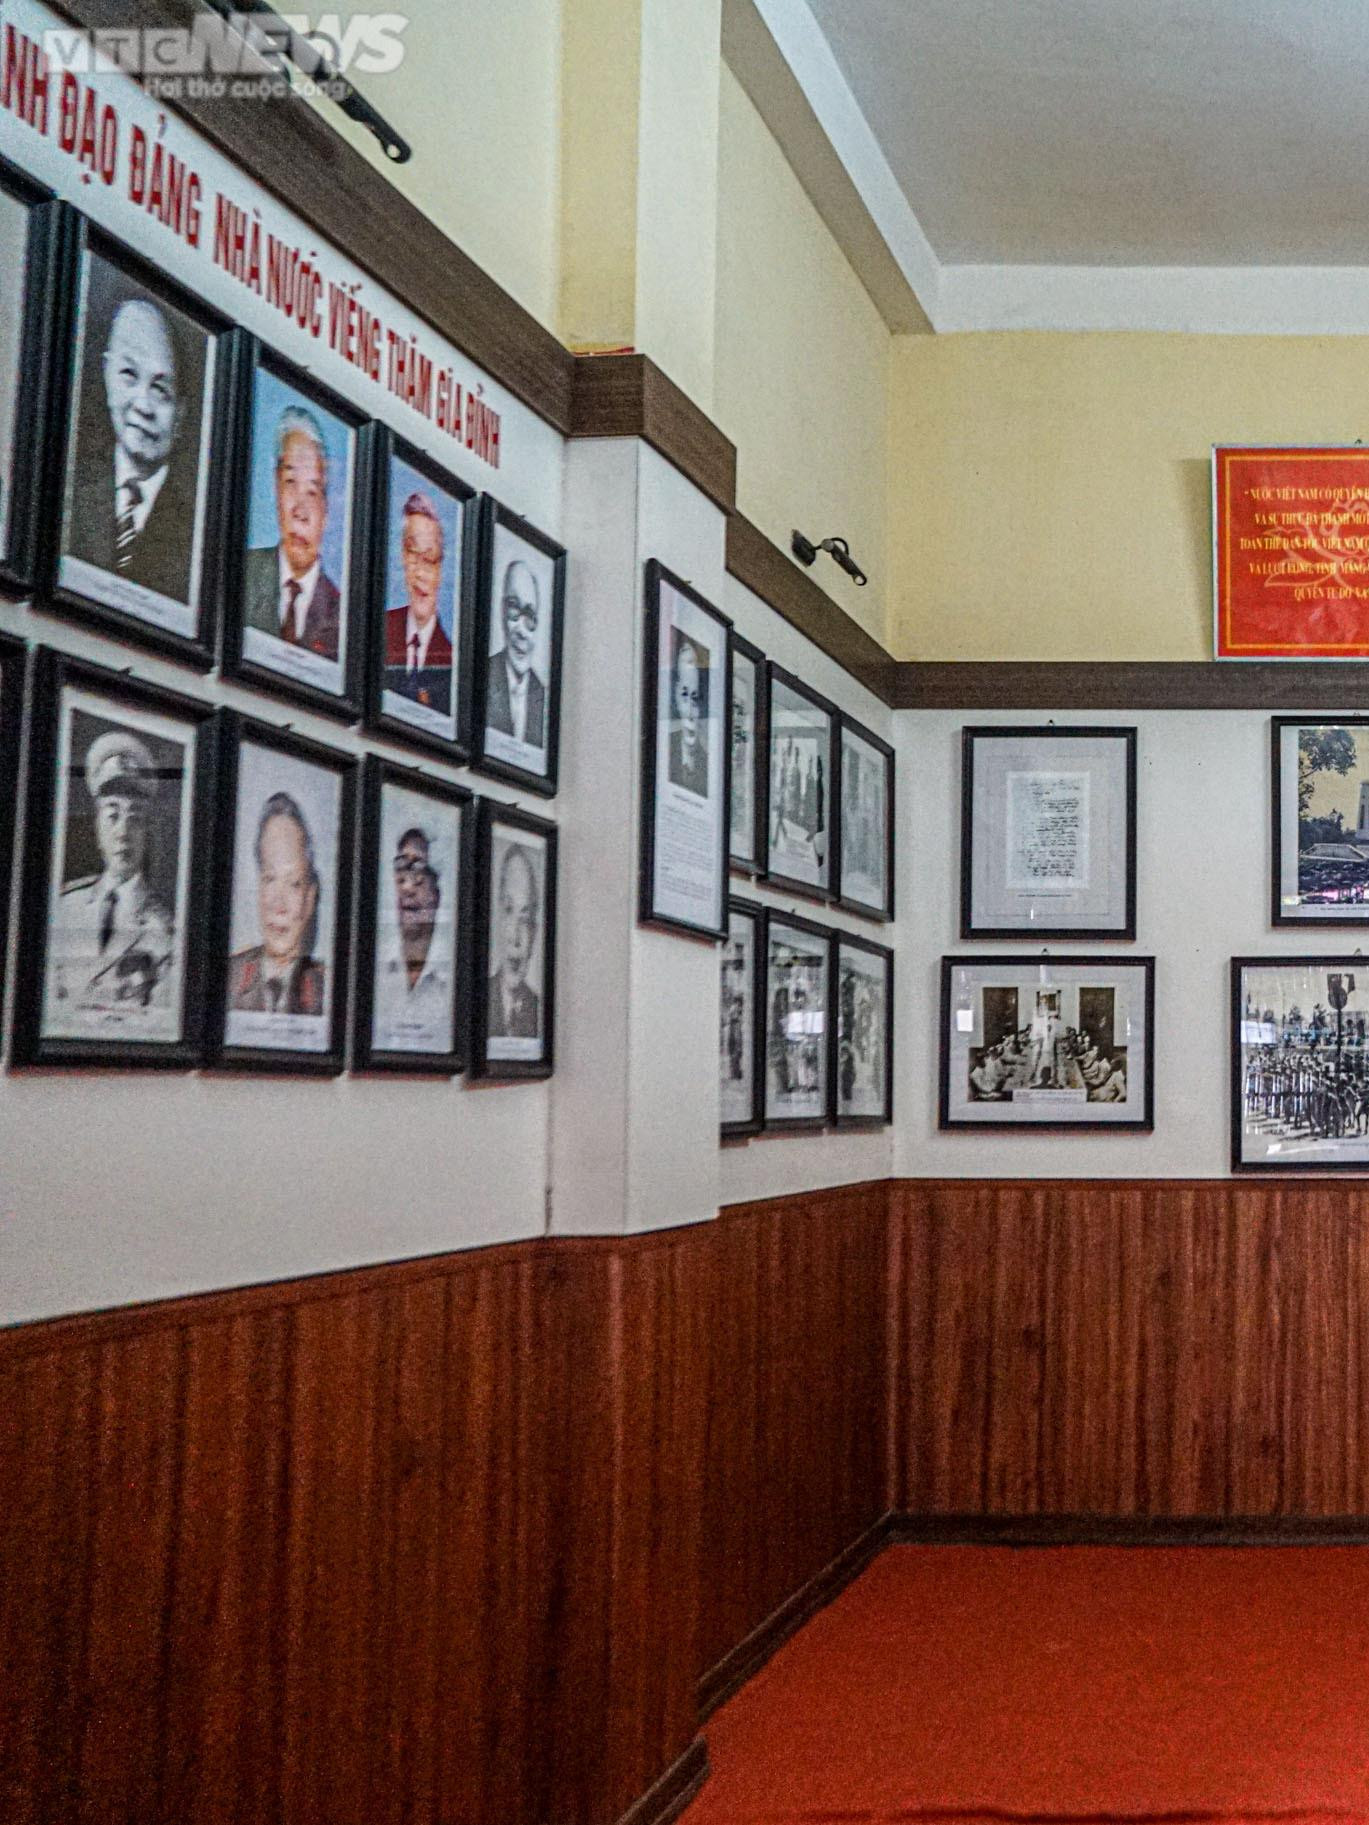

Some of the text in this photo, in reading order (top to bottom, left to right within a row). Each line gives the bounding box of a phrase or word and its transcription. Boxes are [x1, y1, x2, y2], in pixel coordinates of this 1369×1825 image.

[58, 68, 118, 186] ĐẠO
[128, 113, 203, 249] ĐẢNG
[213, 192, 262, 296] NHÀ
[265, 233, 324, 339] NƯỚC
